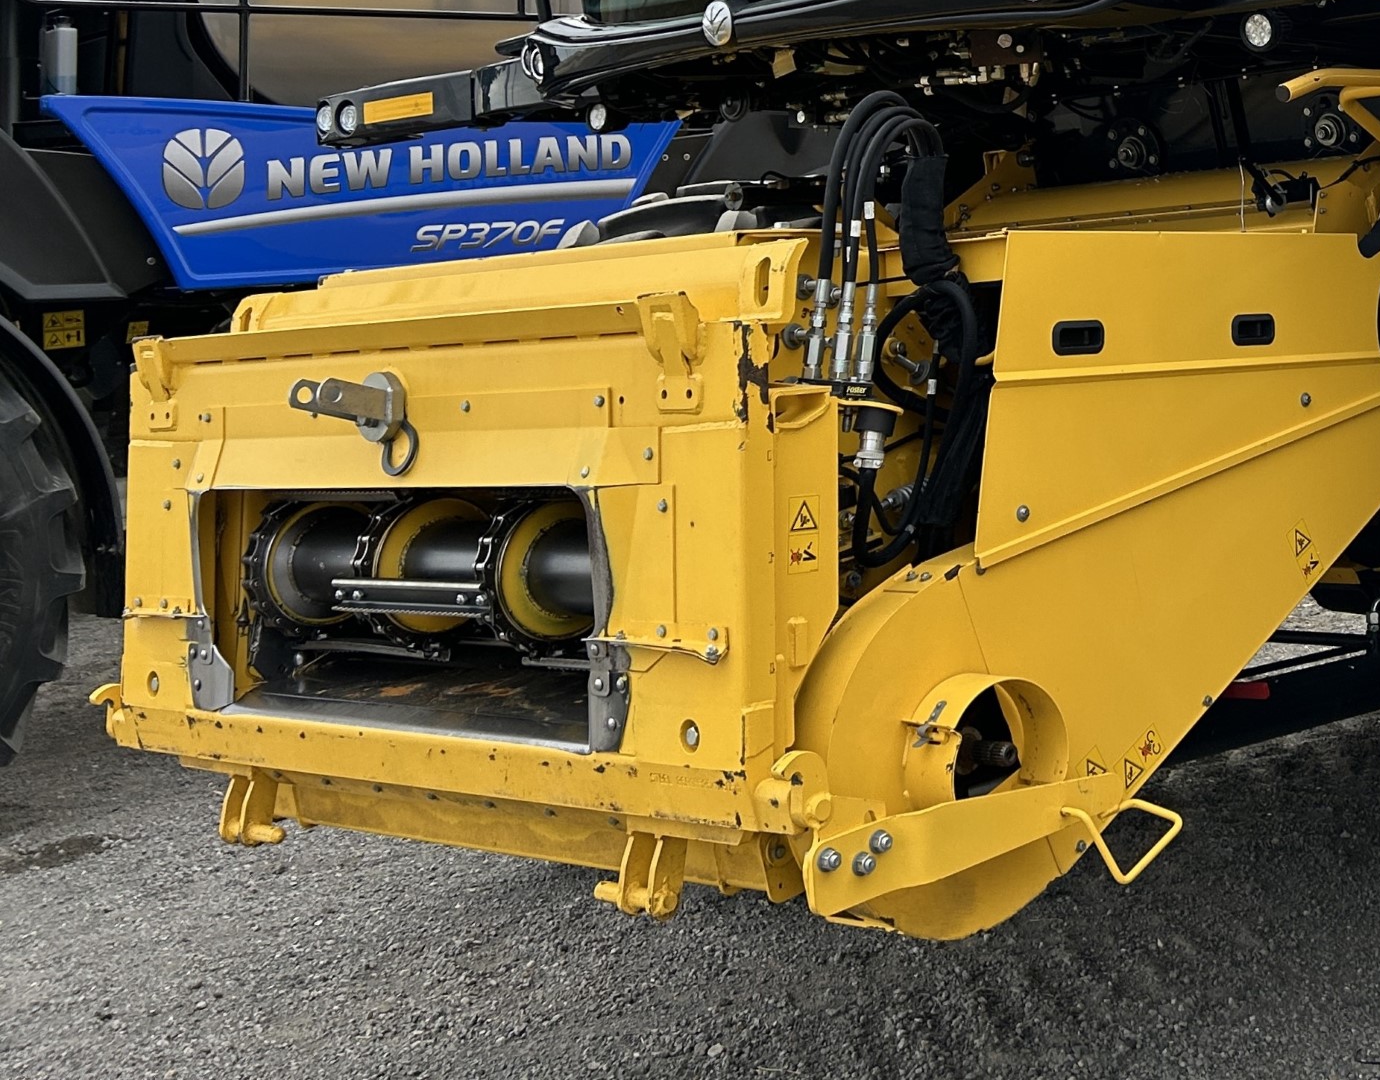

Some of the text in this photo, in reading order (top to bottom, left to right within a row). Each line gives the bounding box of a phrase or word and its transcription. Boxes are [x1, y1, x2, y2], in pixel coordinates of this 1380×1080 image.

[266, 133, 633, 201] NEW HOLLAND
[410, 218, 566, 253] SP370F
